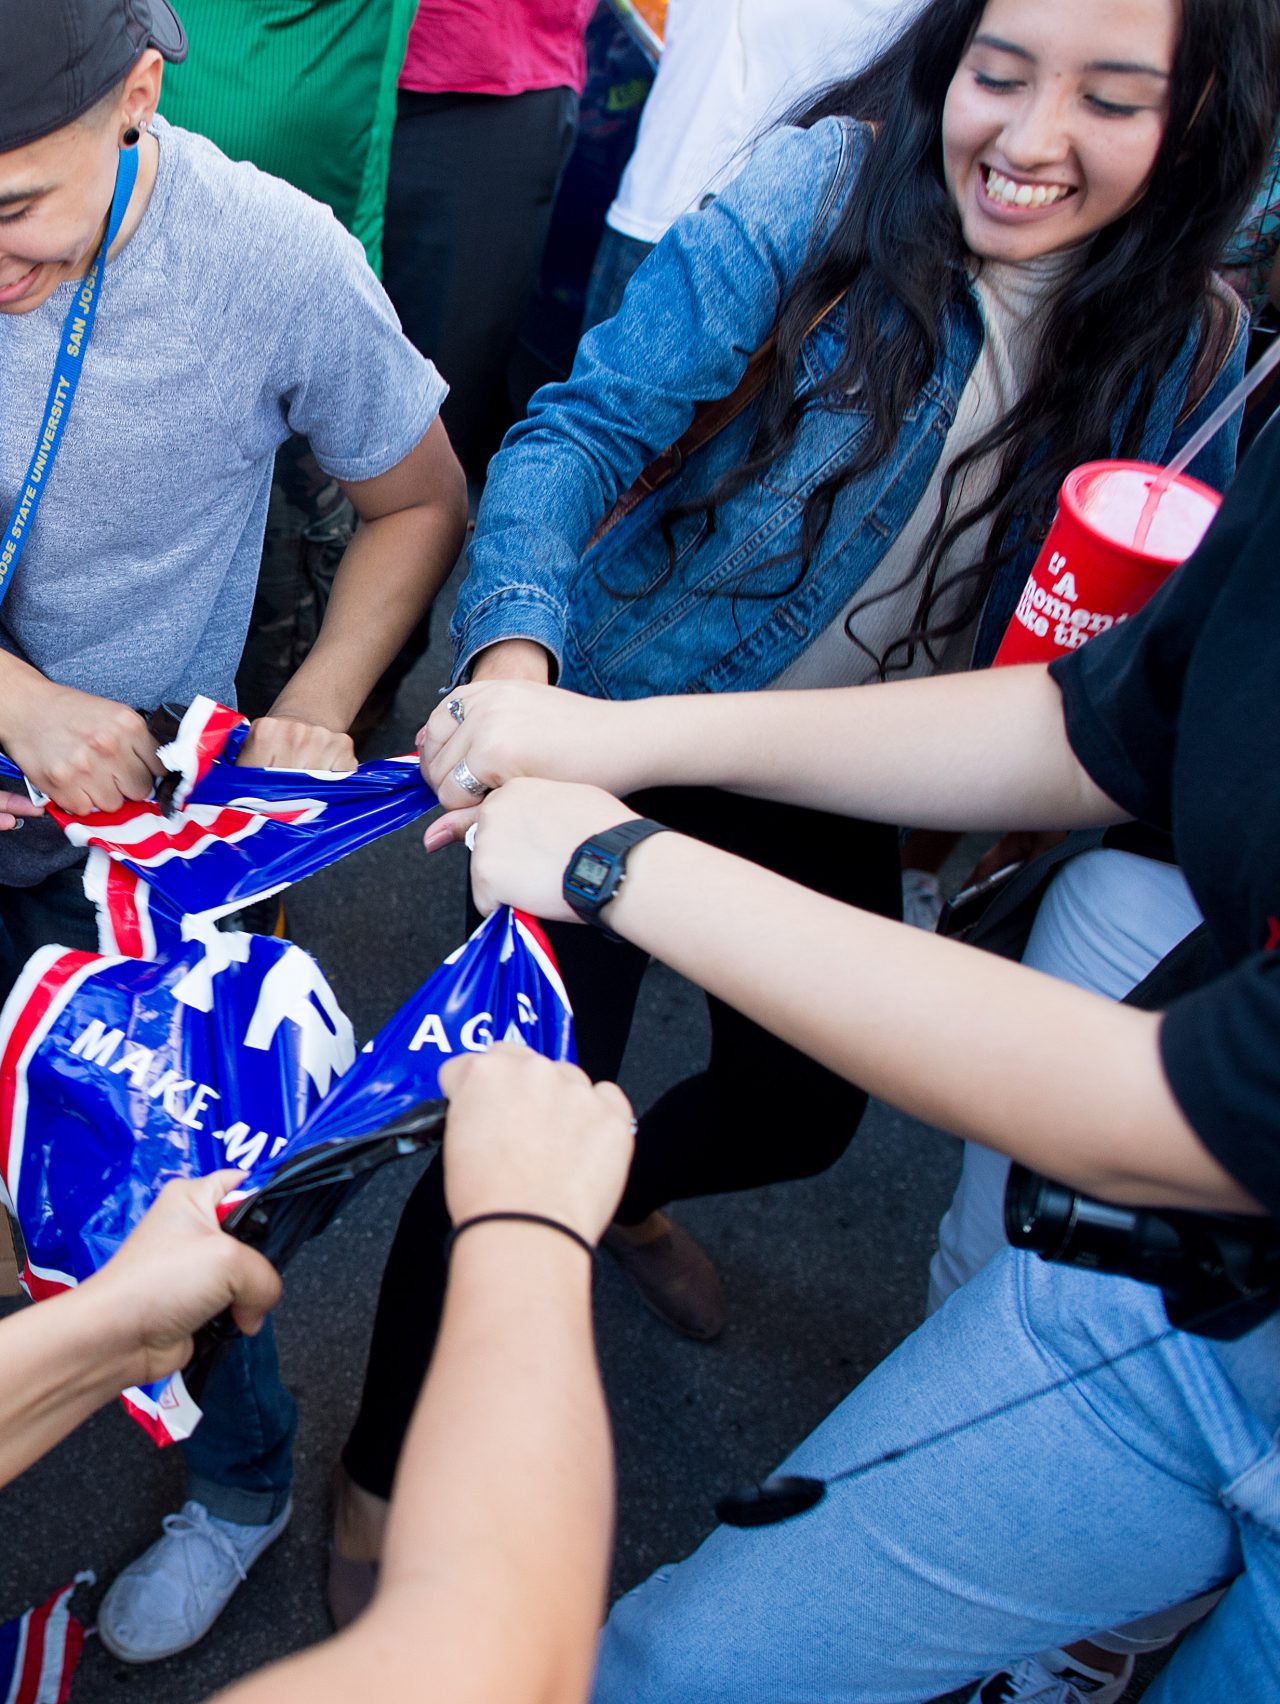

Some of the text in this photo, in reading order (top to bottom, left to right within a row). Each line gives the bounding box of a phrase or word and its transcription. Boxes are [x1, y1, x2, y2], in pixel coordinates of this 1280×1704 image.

[66, 264, 99, 358] SAN JOSE
[11, 484, 37, 539] STATE
[30, 374, 70, 484] UNIVERSITY
[1019, 573, 1129, 634] momen
[68, 1018, 221, 1131] MAKE
